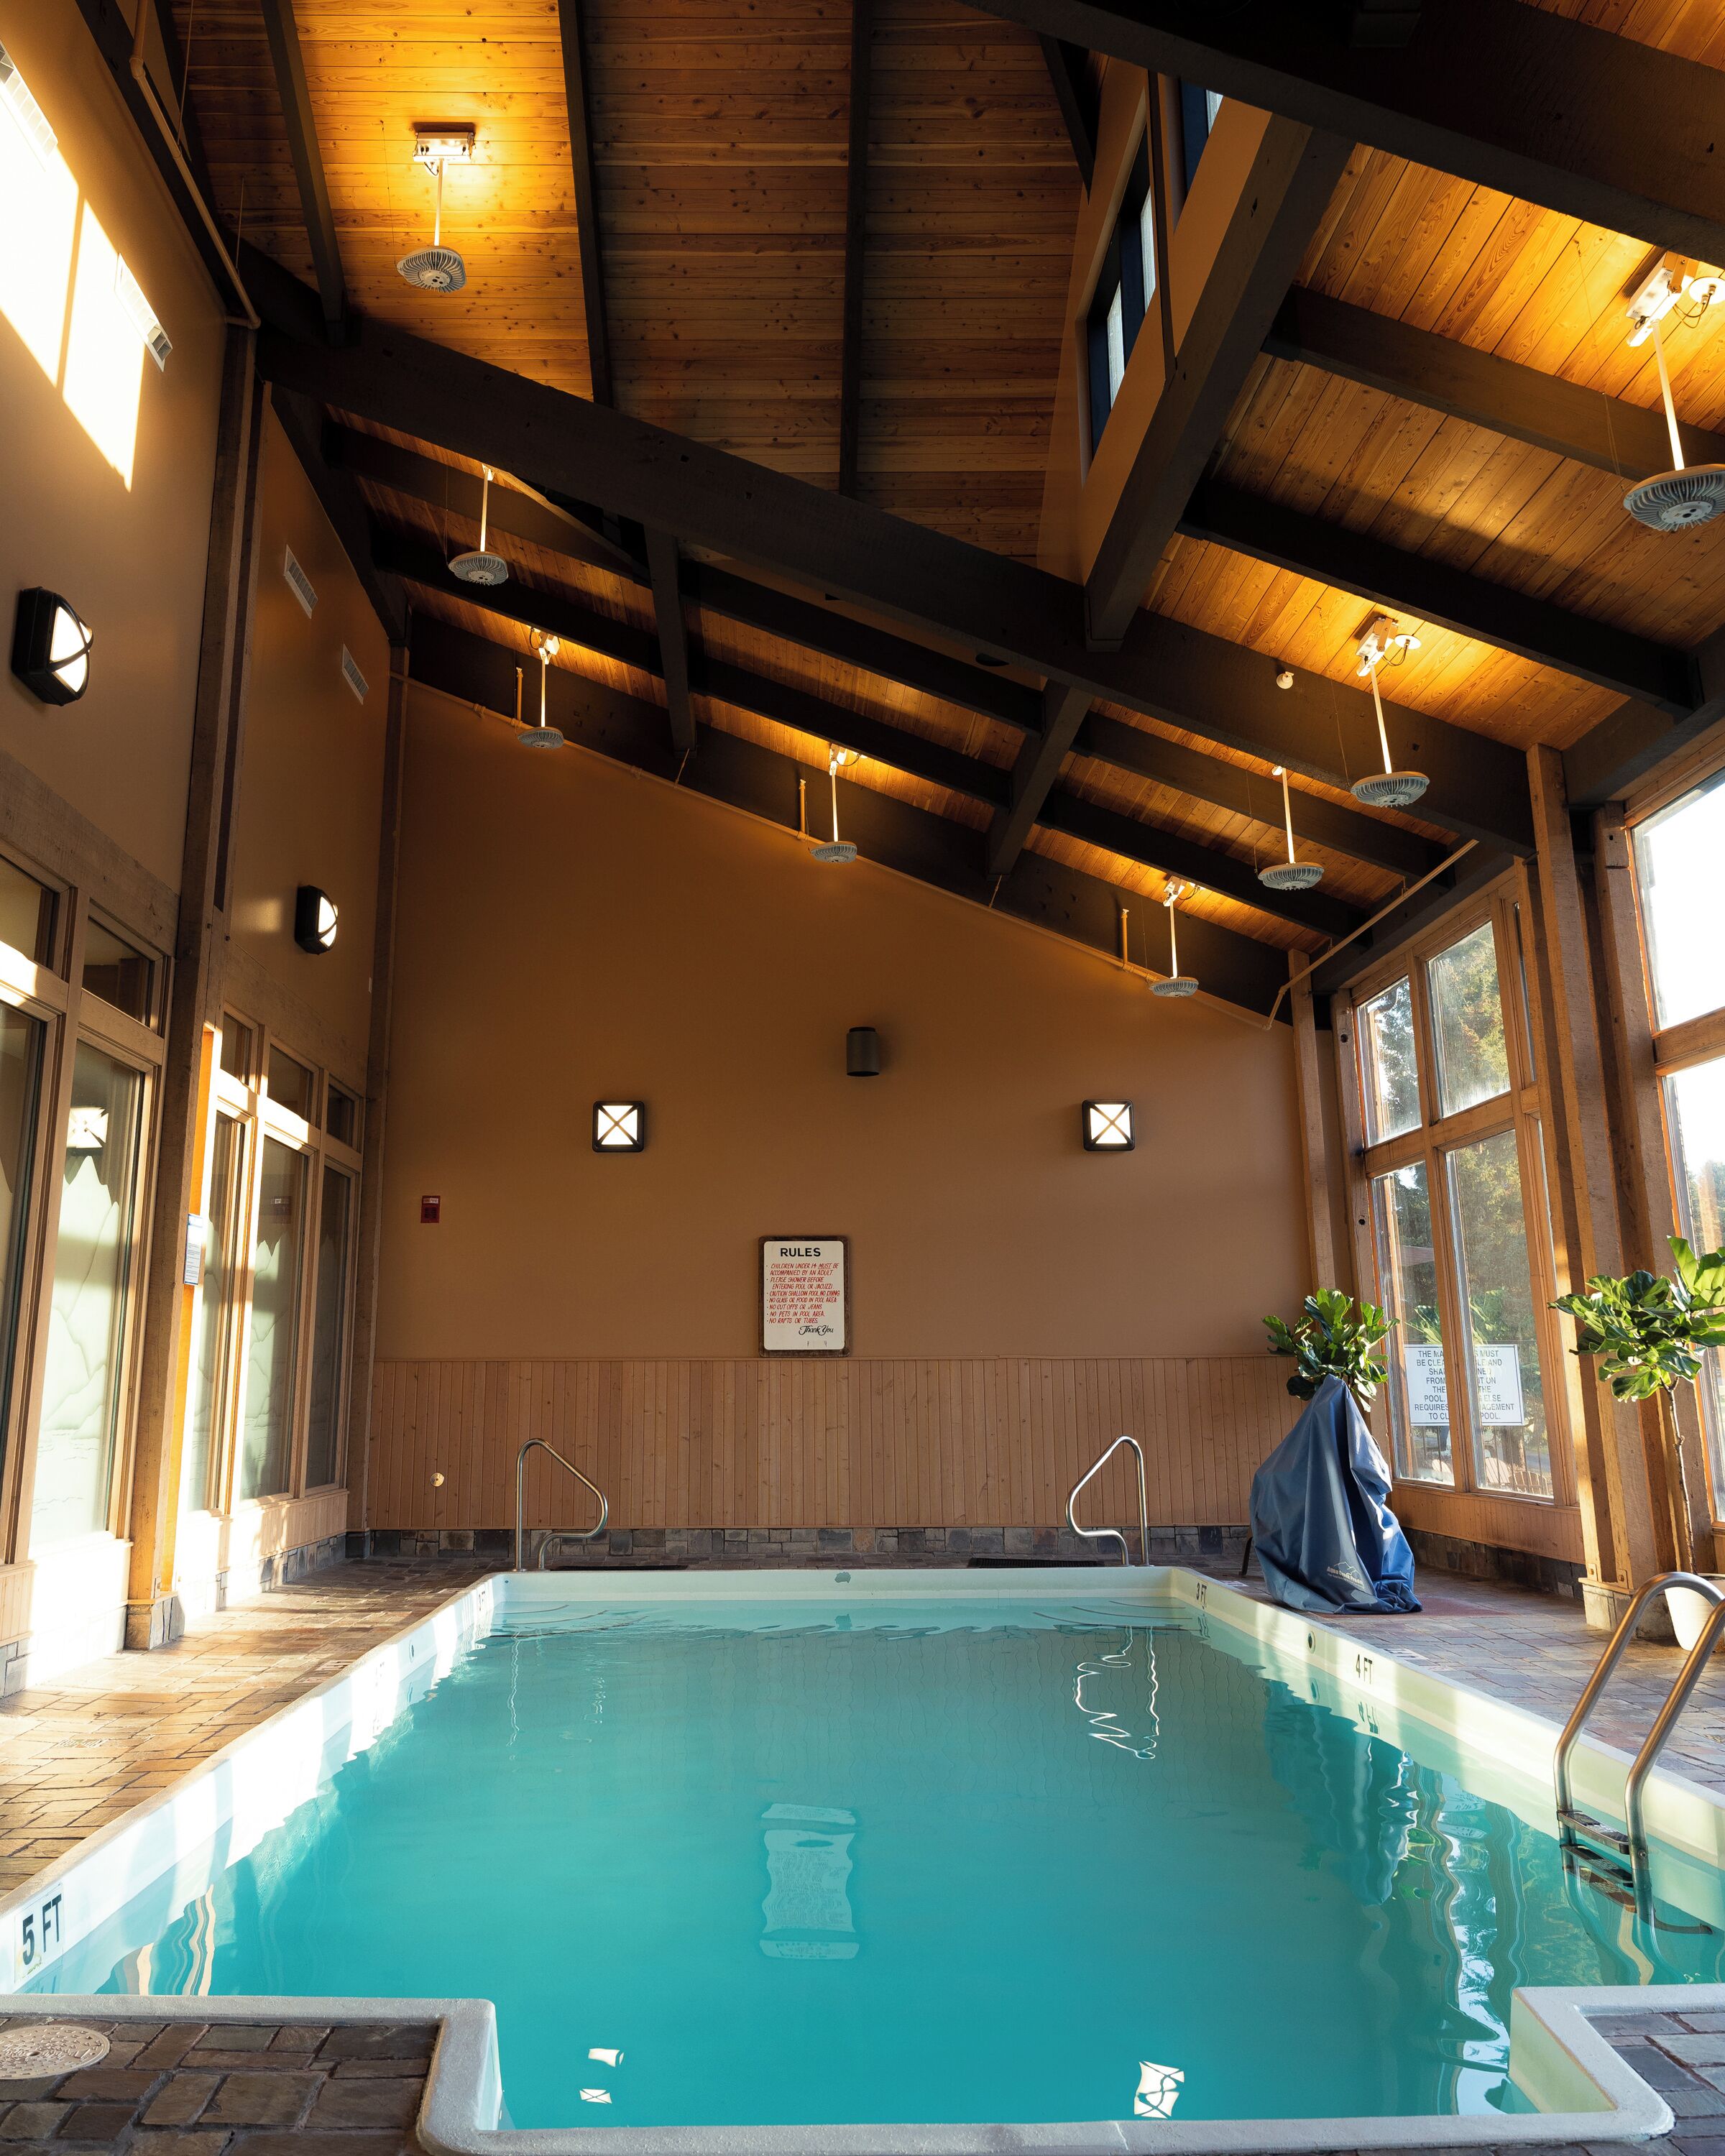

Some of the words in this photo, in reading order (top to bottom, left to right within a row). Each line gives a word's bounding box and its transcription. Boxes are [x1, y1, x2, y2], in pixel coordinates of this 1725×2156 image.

[781, 1248, 821, 1256] RULES
[799, 1325, 820, 1335] Thank
[818, 1325, 834, 1336] You
[1196, 1583, 1200, 1600] 3
[1200, 1584, 1207, 1604] FT
[1356, 1654, 1361, 1678] 4
[1363, 1657, 1373, 1685] FT
[22, 1914, 35, 1966] 5
[42, 1894, 62, 1953] FT
